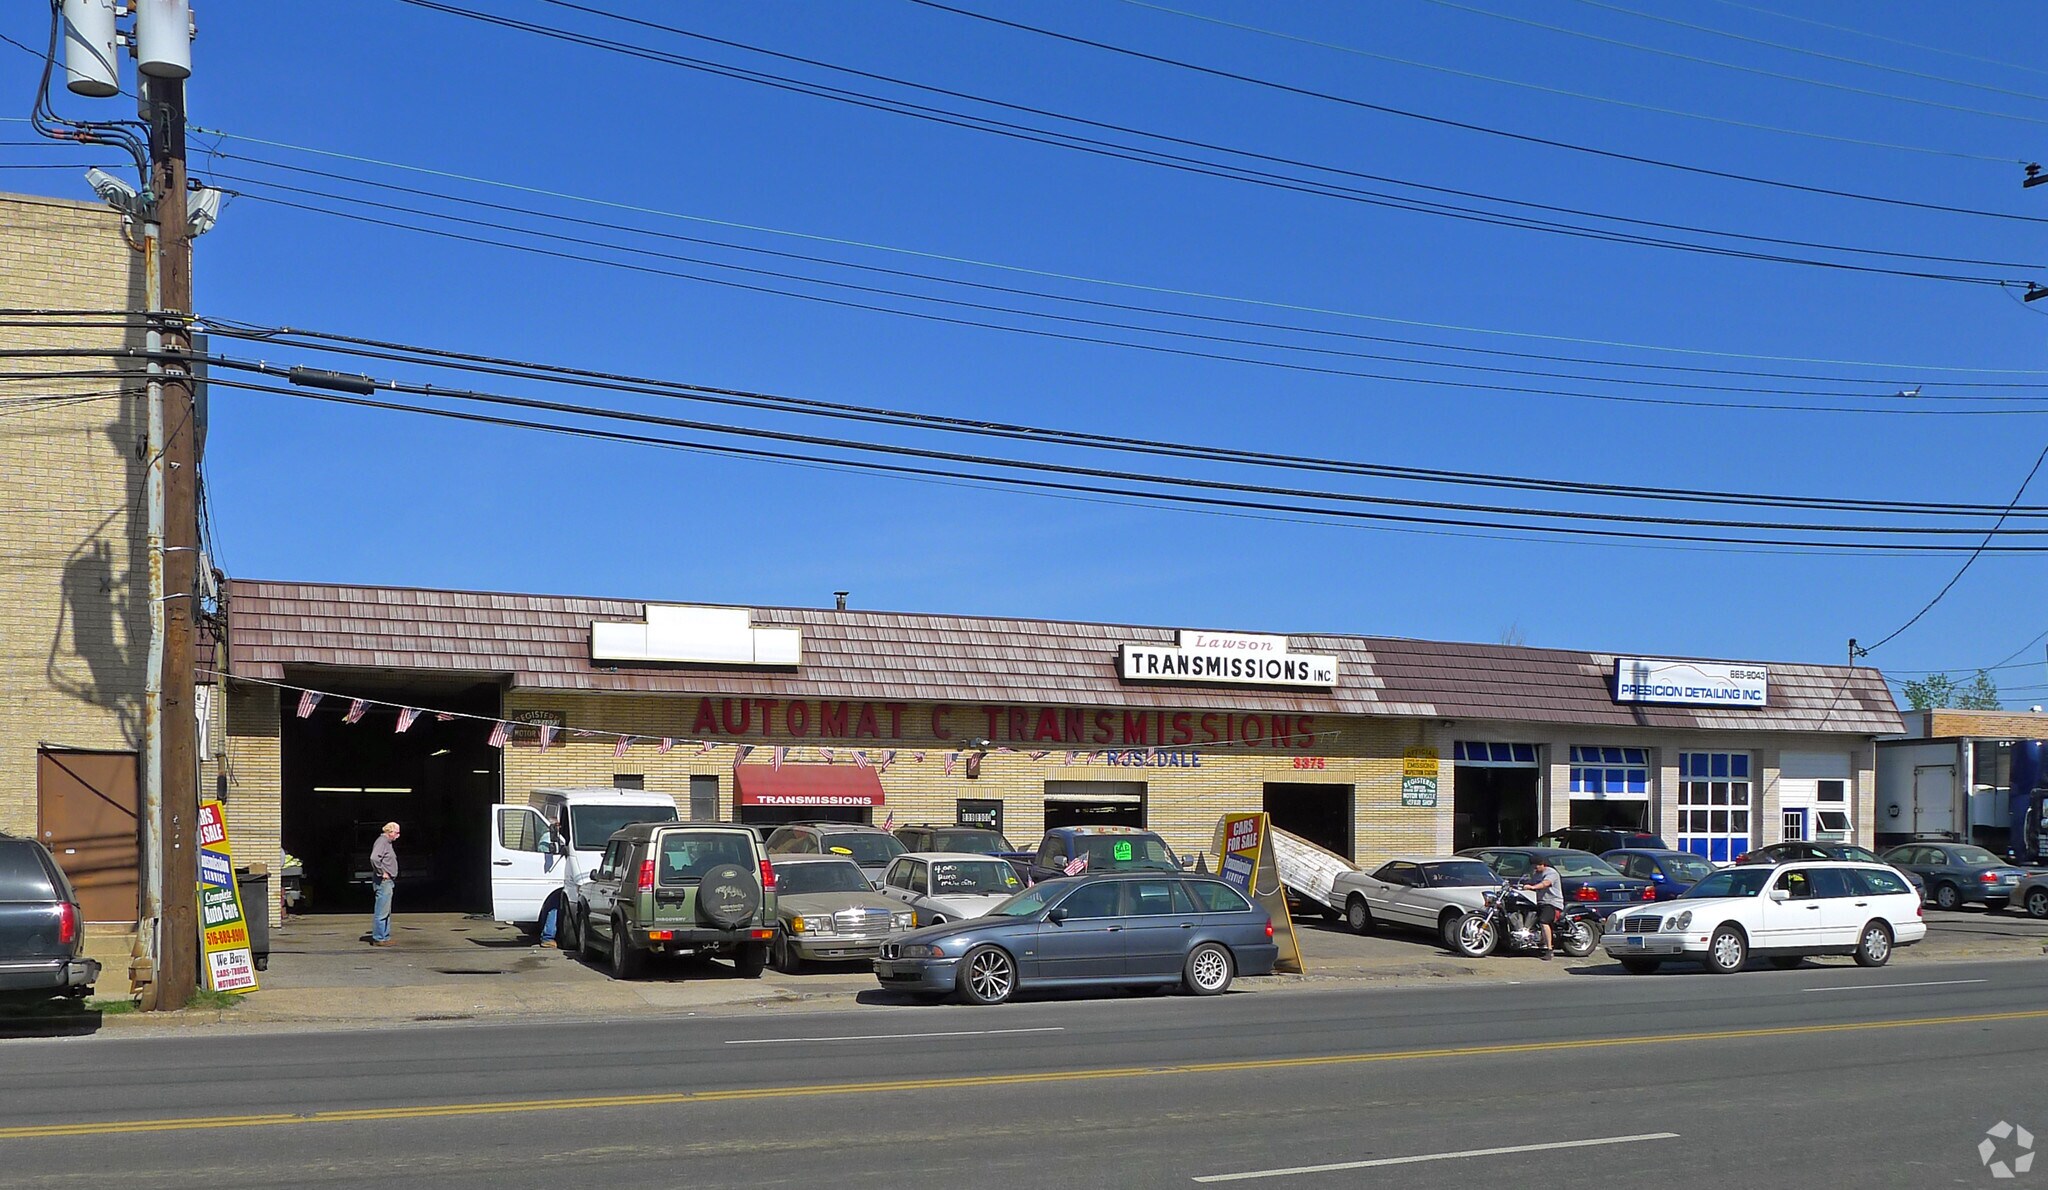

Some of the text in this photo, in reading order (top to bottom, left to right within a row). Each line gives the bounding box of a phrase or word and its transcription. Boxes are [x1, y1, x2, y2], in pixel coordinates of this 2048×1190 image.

[1195, 635, 1273, 650] Lawson
[1132, 653, 1334, 682] TRANSMISSIONS INC.
[1621, 684, 1763, 700] PRESICION DETAILING INC.
[982, 705, 1316, 747] TRANSMISSIONS
[1293, 757, 1325, 769] 3375
[1403, 778, 1436, 789] REGISTERED
[757, 795, 872, 804] TRANSMISSIONS
[203, 824, 224, 843] SALE
[1233, 819, 1254, 837] CARS
[1227, 832, 1258, 852] FOR SALE
[204, 905, 222, 924] Auto
[216, 955, 227, 967] We
